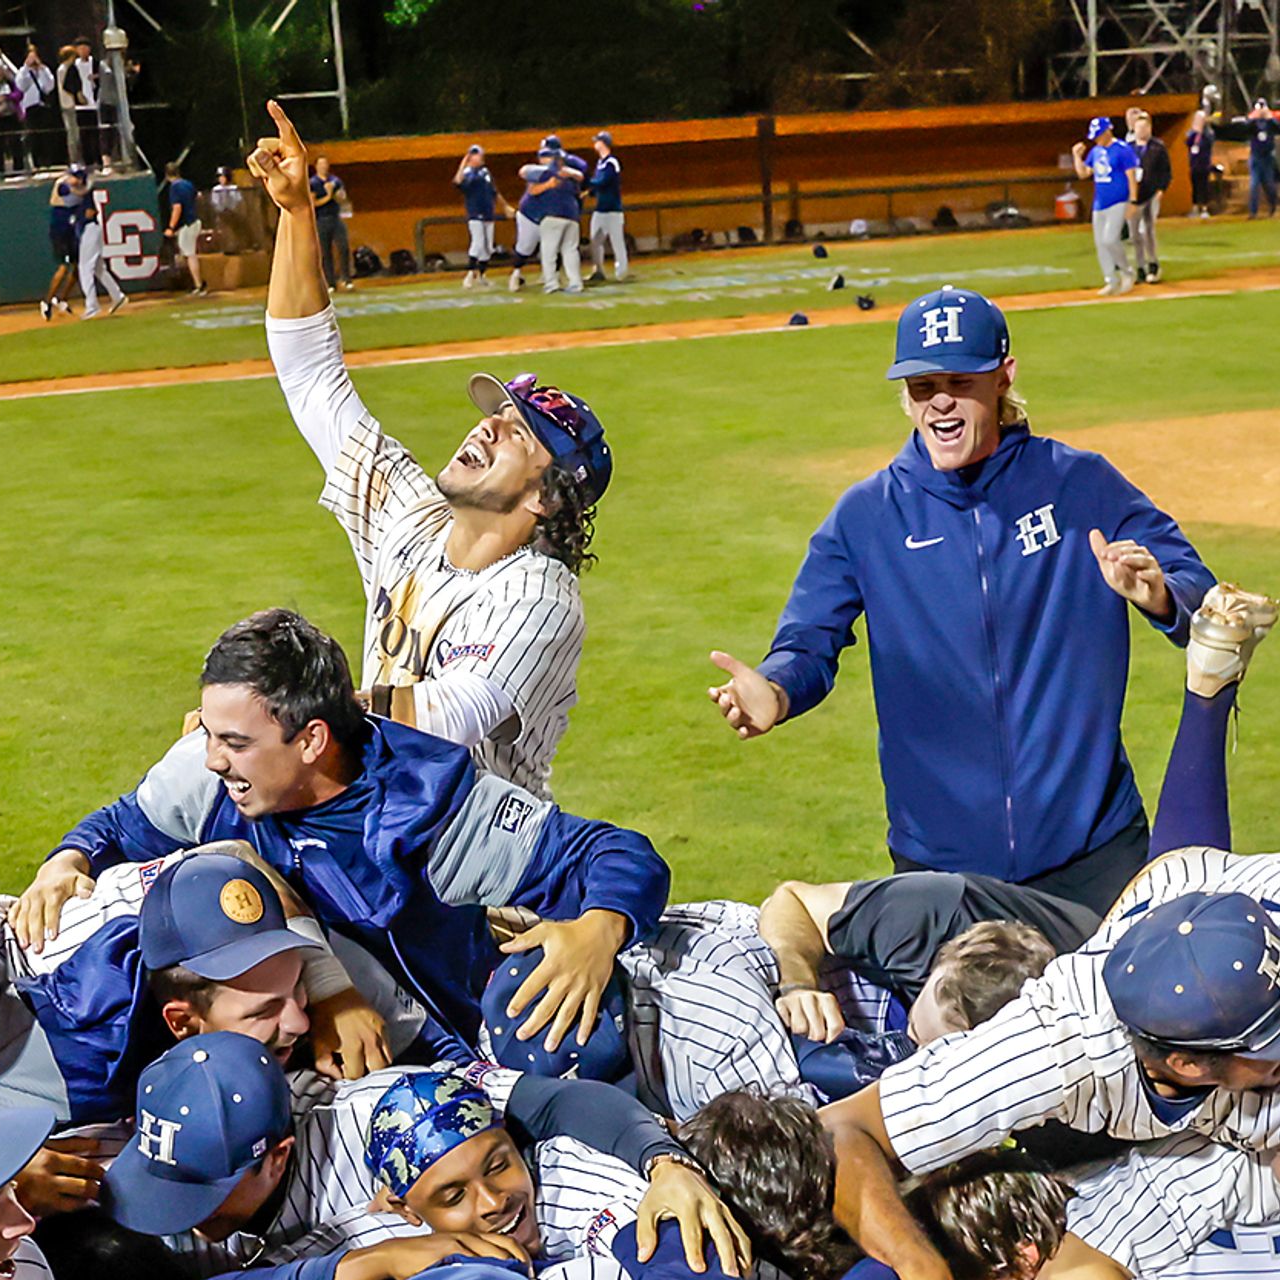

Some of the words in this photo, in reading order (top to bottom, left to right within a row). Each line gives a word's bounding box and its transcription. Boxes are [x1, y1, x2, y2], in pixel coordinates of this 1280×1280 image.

[919, 305, 964, 348] H
[1014, 503, 1062, 558] H
[447, 643, 491, 662] NAIA
[137, 1109, 183, 1167] H
